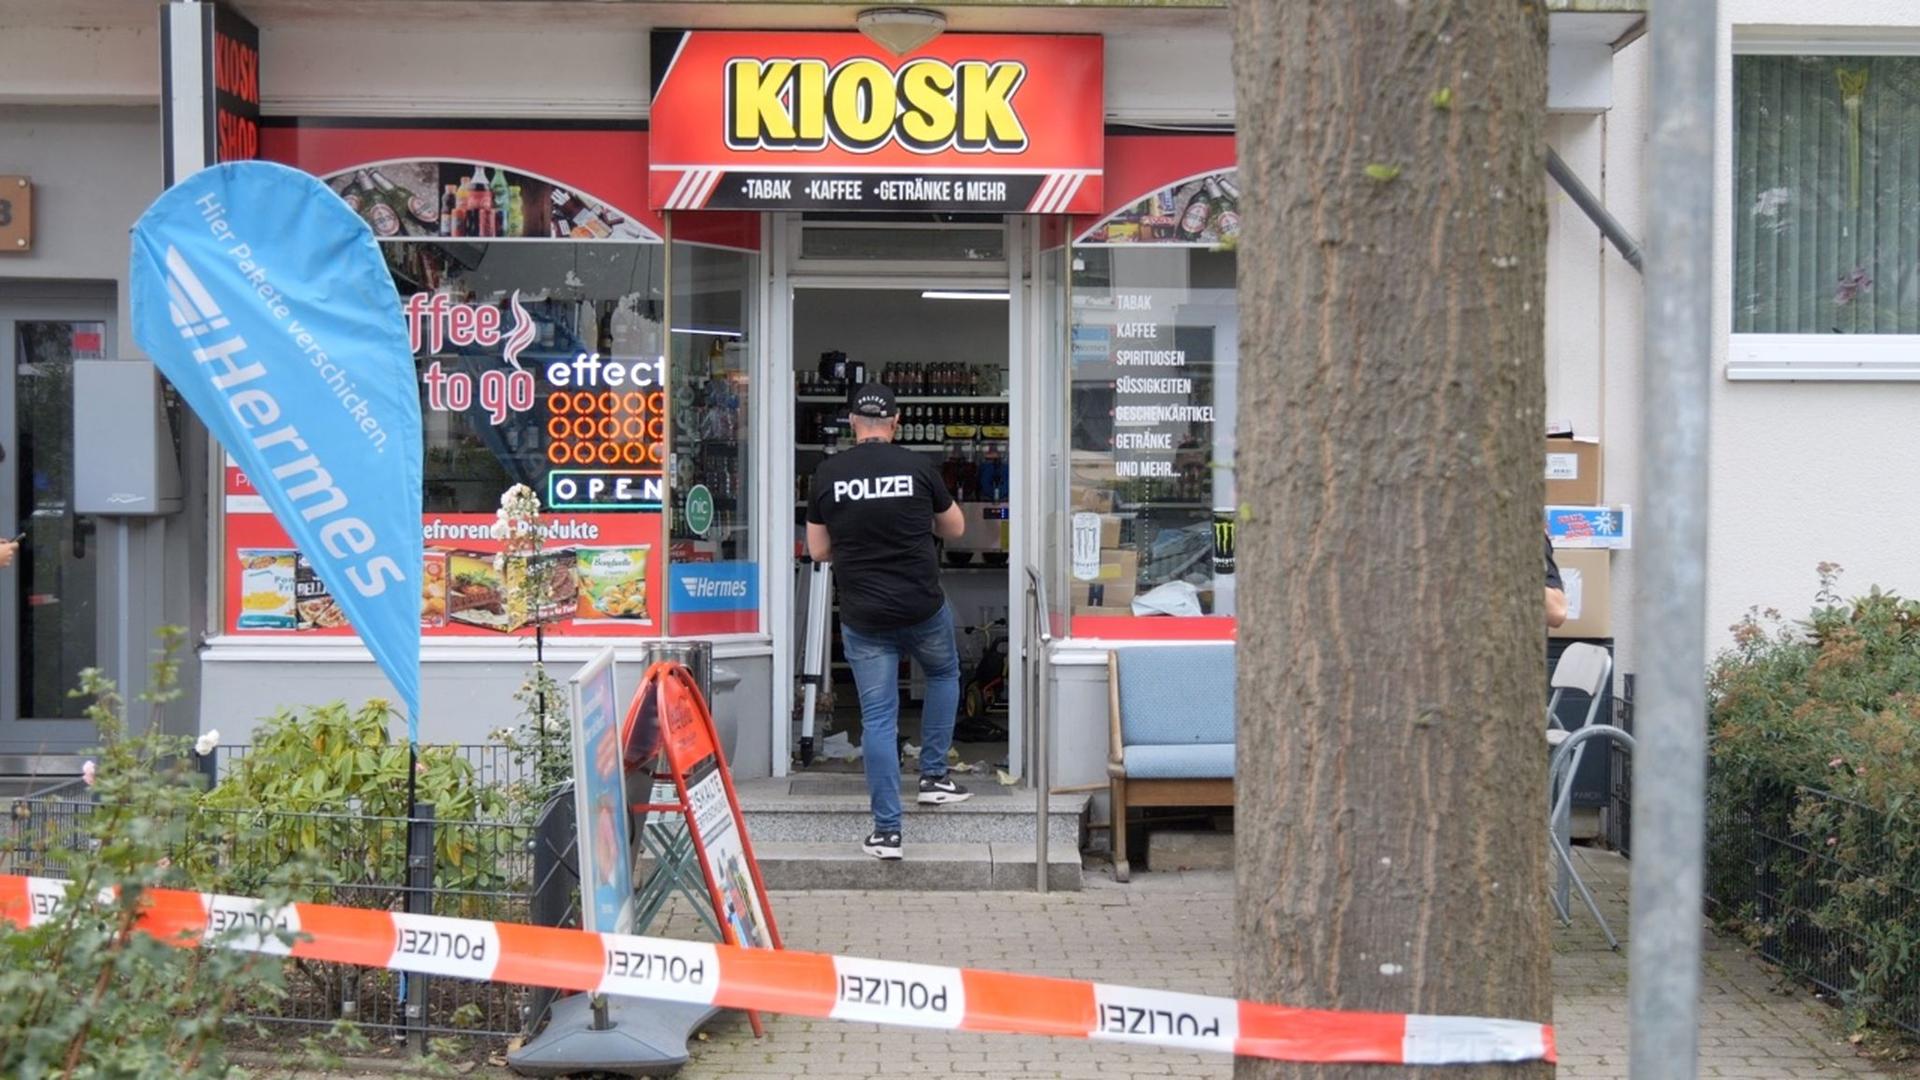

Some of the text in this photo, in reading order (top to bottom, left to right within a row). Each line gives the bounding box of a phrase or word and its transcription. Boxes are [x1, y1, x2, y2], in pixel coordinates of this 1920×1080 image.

[216, 32, 258, 104] KIOSK
[725, 57, 1029, 154] KIOSK
[218, 109, 258, 162] SHOP
[954, 182, 964, 200] &
[966, 182, 1007, 201] MEHR
[1117, 295, 1152, 310] TABAK
[195, 191, 388, 454] Hier Pakete verschicken.
[403, 292, 502, 354] ffee
[1116, 322, 1158, 338] KAFFEE
[547, 353, 665, 386] effect
[1116, 350, 1186, 366] SPIRITUOSEN
[423, 361, 535, 426] to go
[1116, 375, 1192, 394] SÜSSIGKEITEN
[1116, 431, 1172, 449] GETRÄNKE
[192, 335, 406, 598] Hermes
[1116, 461, 1138, 477] UND
[555, 478, 663, 500] OPEN
[833, 475, 914, 503] POLIZEI
[697, 577, 747, 597] Hermes
[397, 927, 485, 962] POLIZEI
[607, 950, 704, 985] POLIZEI
[840, 974, 948, 1013] POLIZEI
